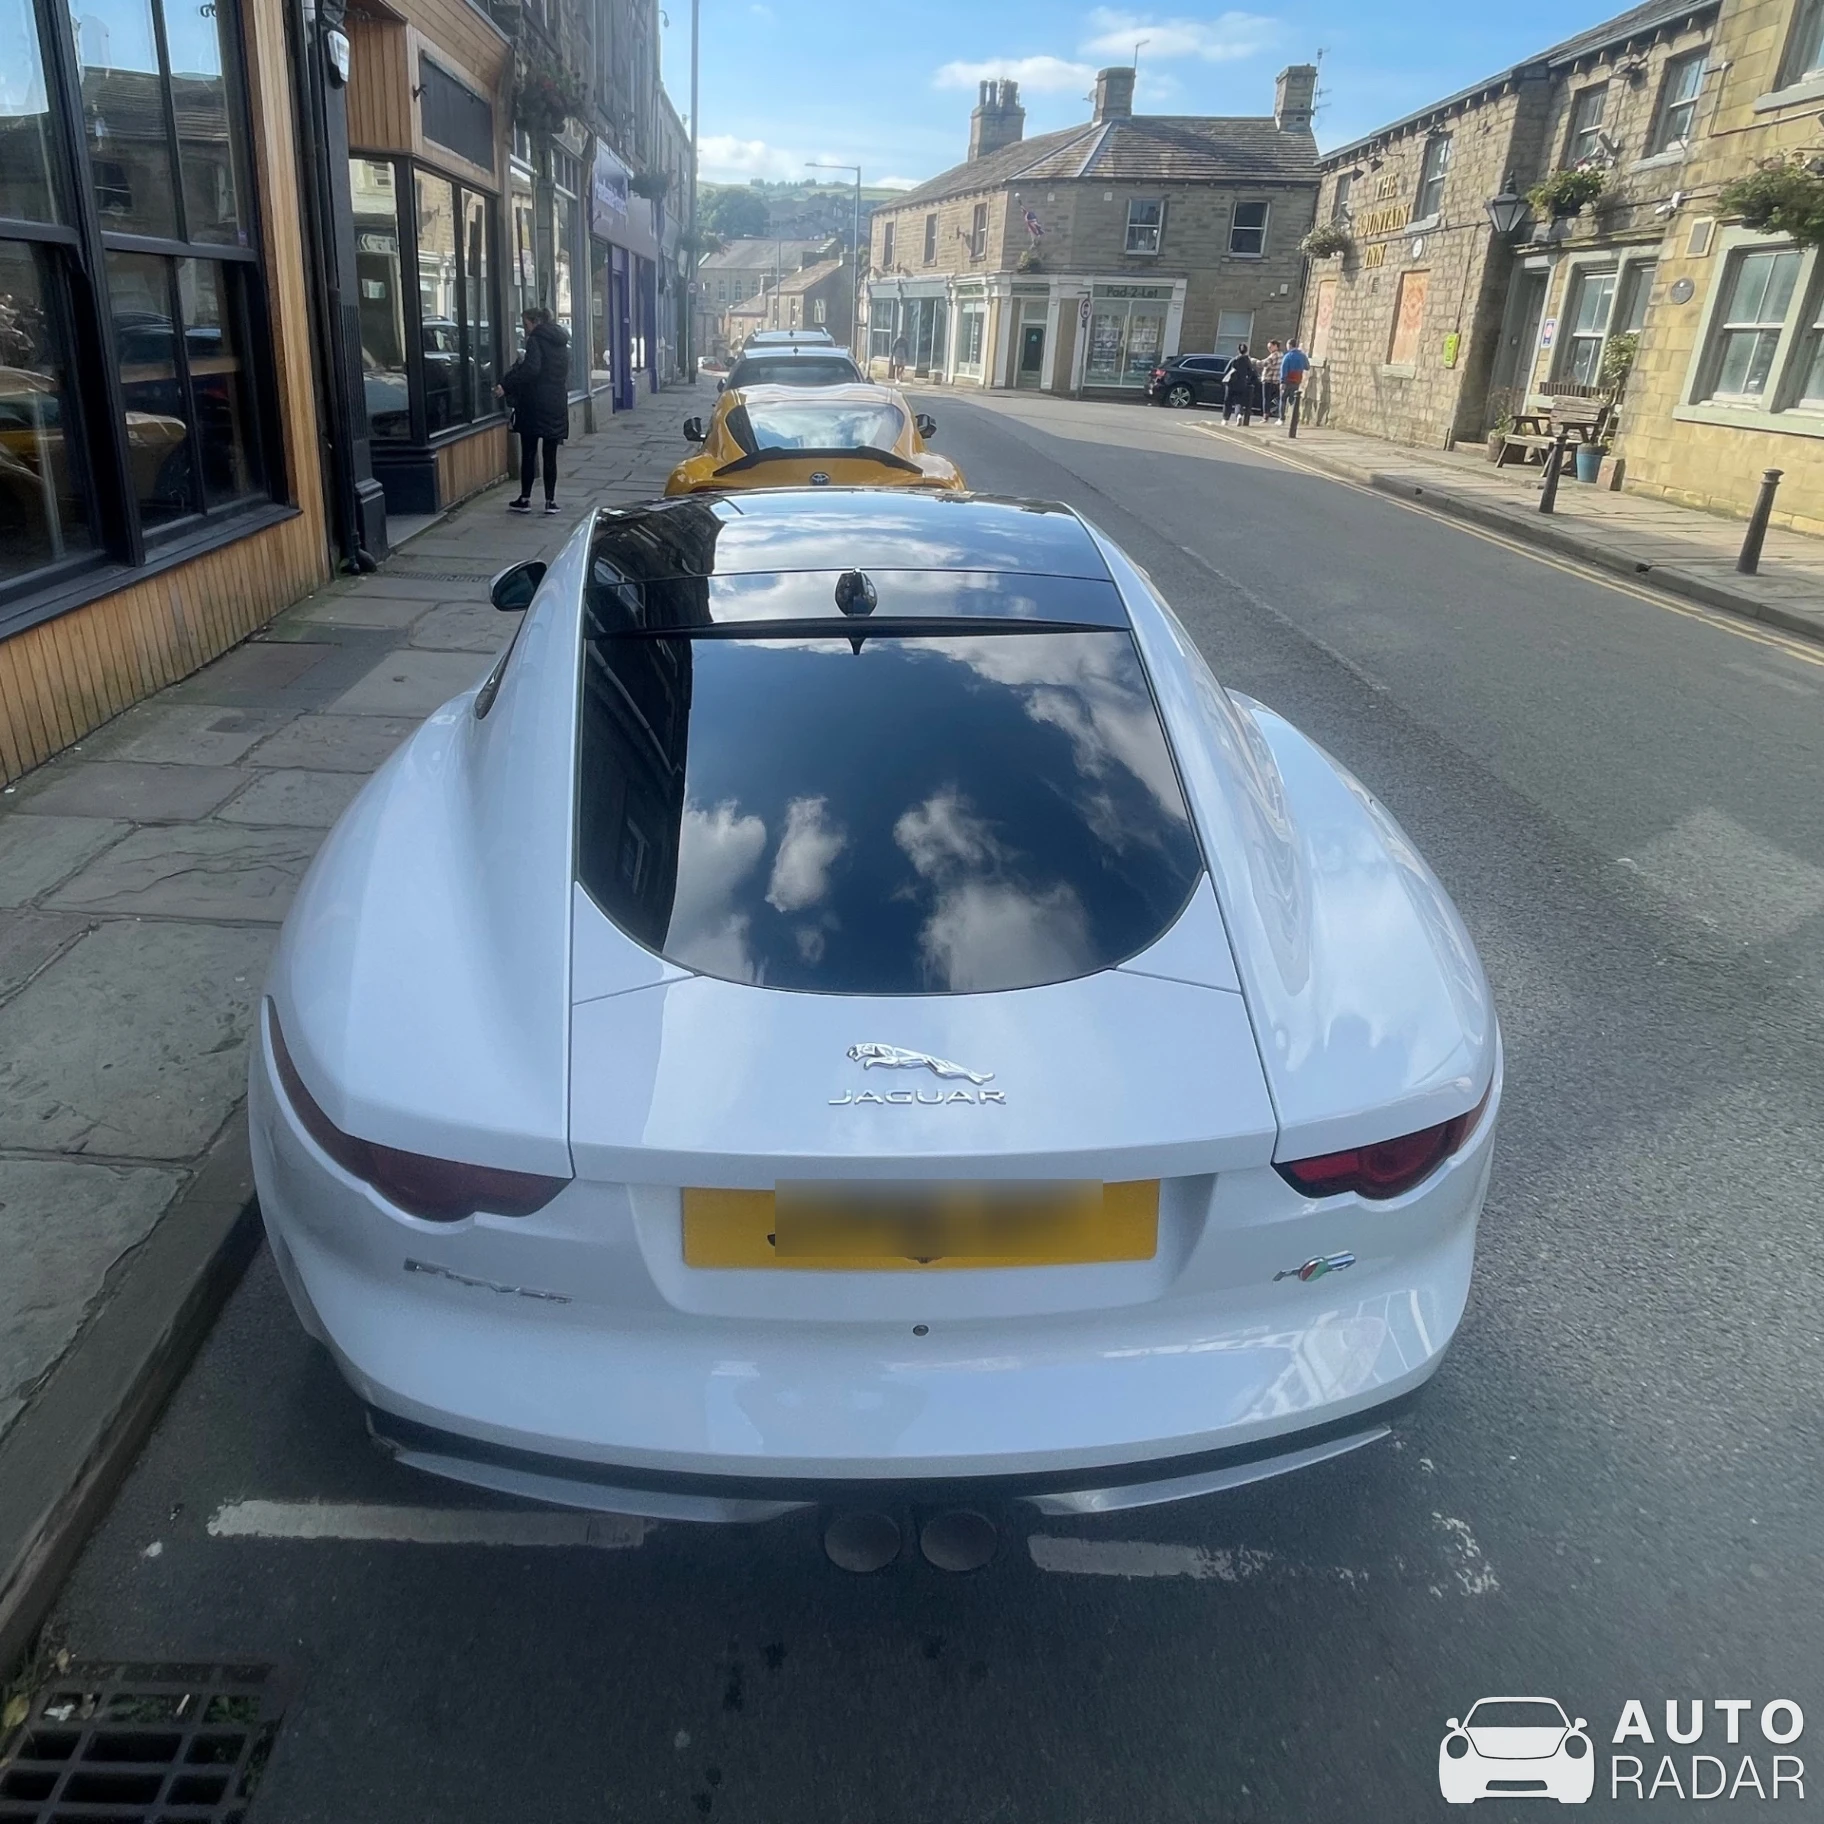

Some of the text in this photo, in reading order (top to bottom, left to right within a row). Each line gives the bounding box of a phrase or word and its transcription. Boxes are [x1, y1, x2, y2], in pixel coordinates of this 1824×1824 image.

[1375, 173, 1398, 202] THE
[1354, 203, 1410, 238] FOUNTAIN
[1364, 243, 1387, 269] INN
[1106, 285, 1158, 299] Pad-2-Let
[828, 1088, 1006, 1105] JAGUAR
